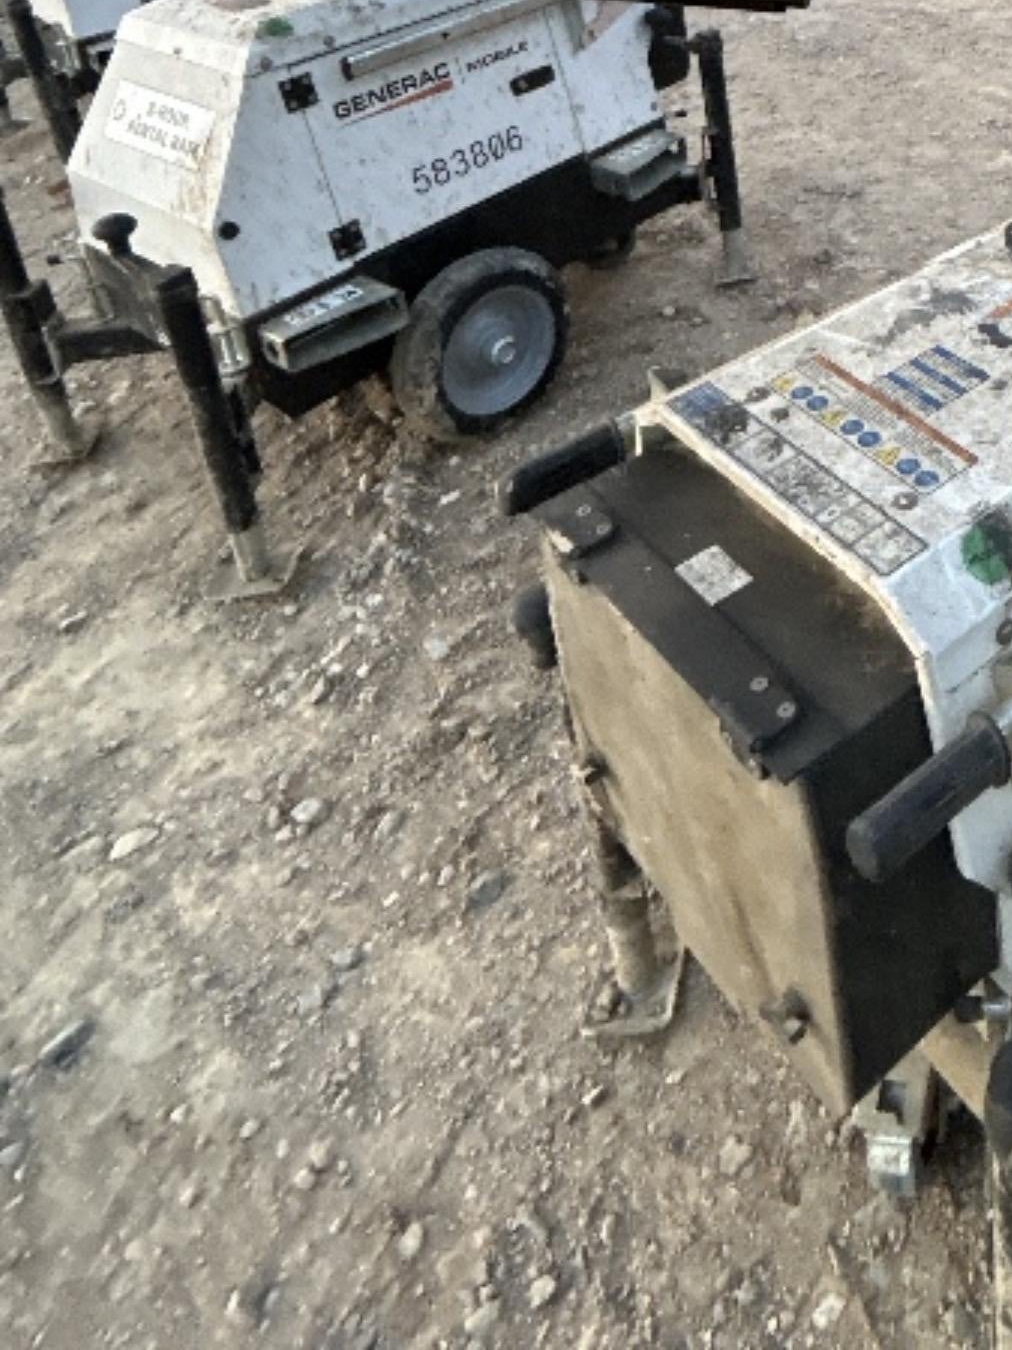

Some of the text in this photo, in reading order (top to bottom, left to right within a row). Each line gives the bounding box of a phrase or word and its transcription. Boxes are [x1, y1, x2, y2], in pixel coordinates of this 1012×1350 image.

[333, 41, 529, 120] GENERAC MOBILE
[411, 125, 524, 194] 583806
